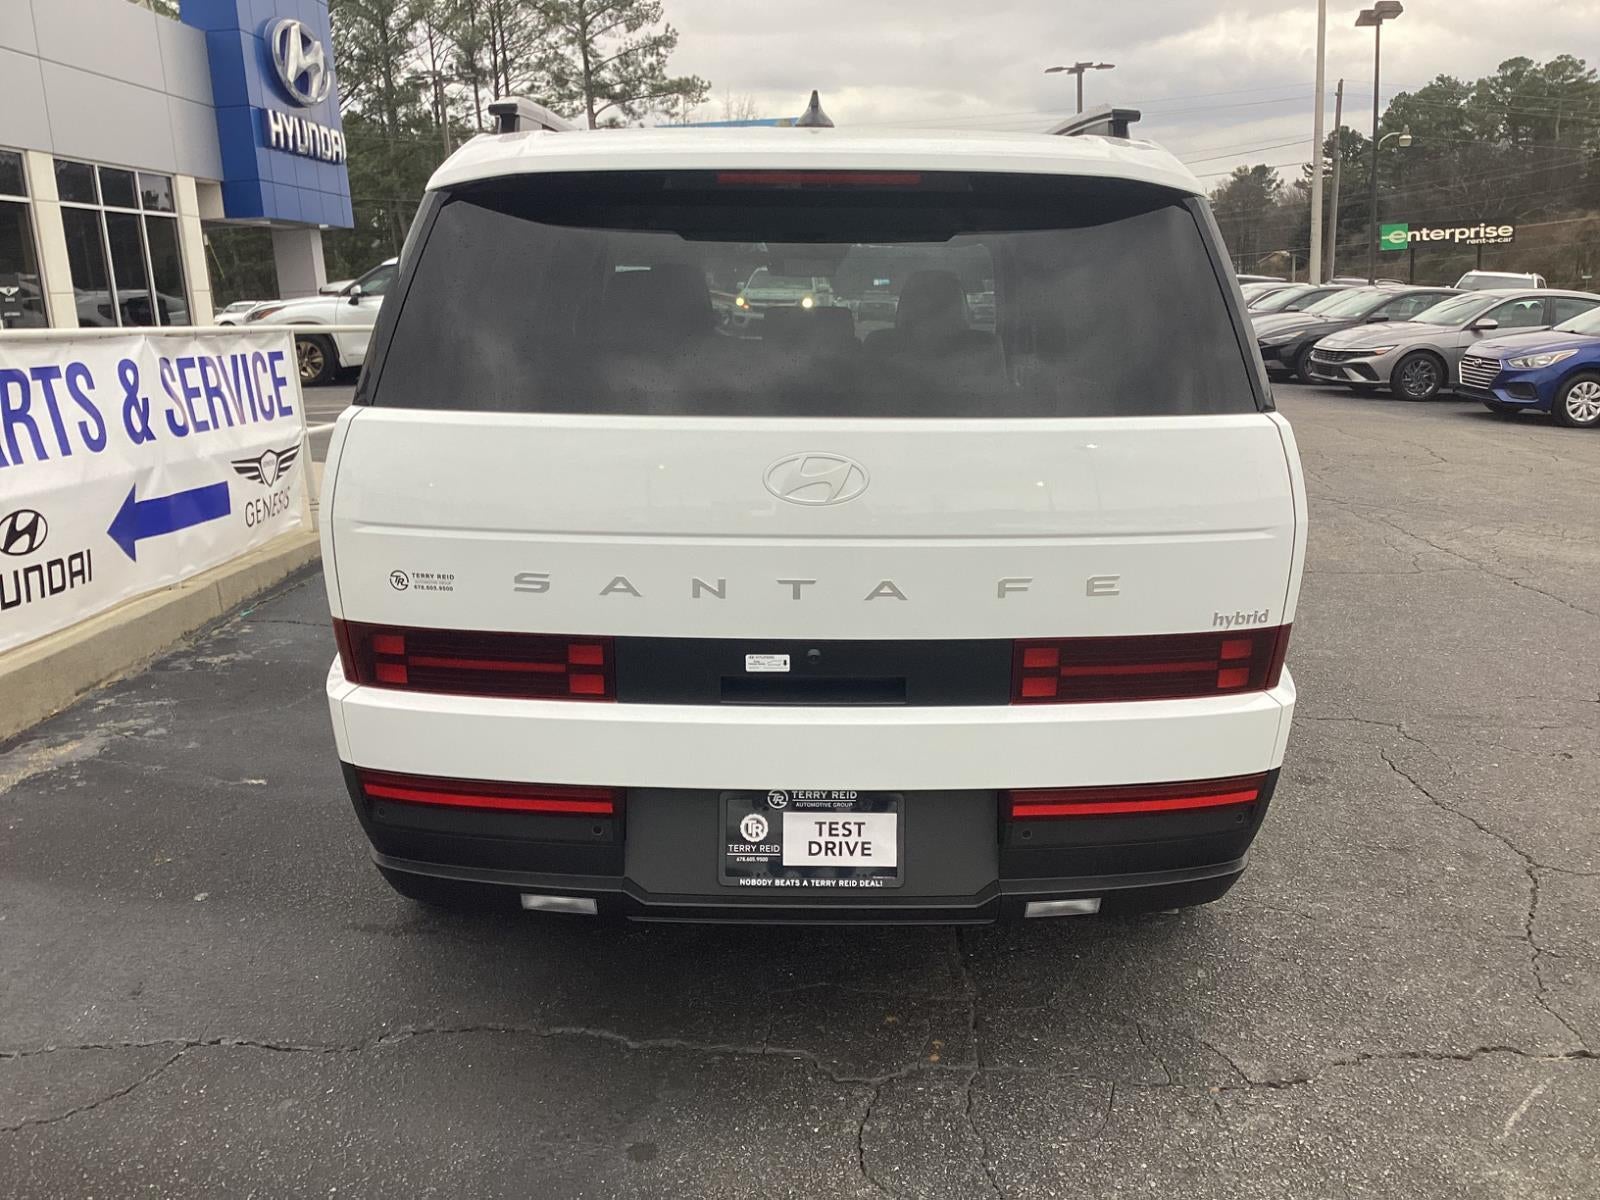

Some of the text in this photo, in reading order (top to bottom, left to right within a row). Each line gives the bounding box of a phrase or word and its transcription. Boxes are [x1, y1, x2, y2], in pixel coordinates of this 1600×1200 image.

[268, 110, 347, 162] HYUNDAI
[1382, 223, 1514, 243] enterprise
[1466, 237, 1513, 245] rent-a-car
[0, 350, 293, 467] RTS & SERVICE
[514, 572, 1120, 601] SANTA FE
[1212, 609, 1269, 629] hybrid
[792, 790, 857, 799] TERRY REID
[815, 822, 866, 837] TEST
[728, 844, 781, 853] TERRY REID
[808, 841, 872, 857] DRIVE
[739, 878, 883, 887] NOBODY BEATS A TERRY REID DEAL!
